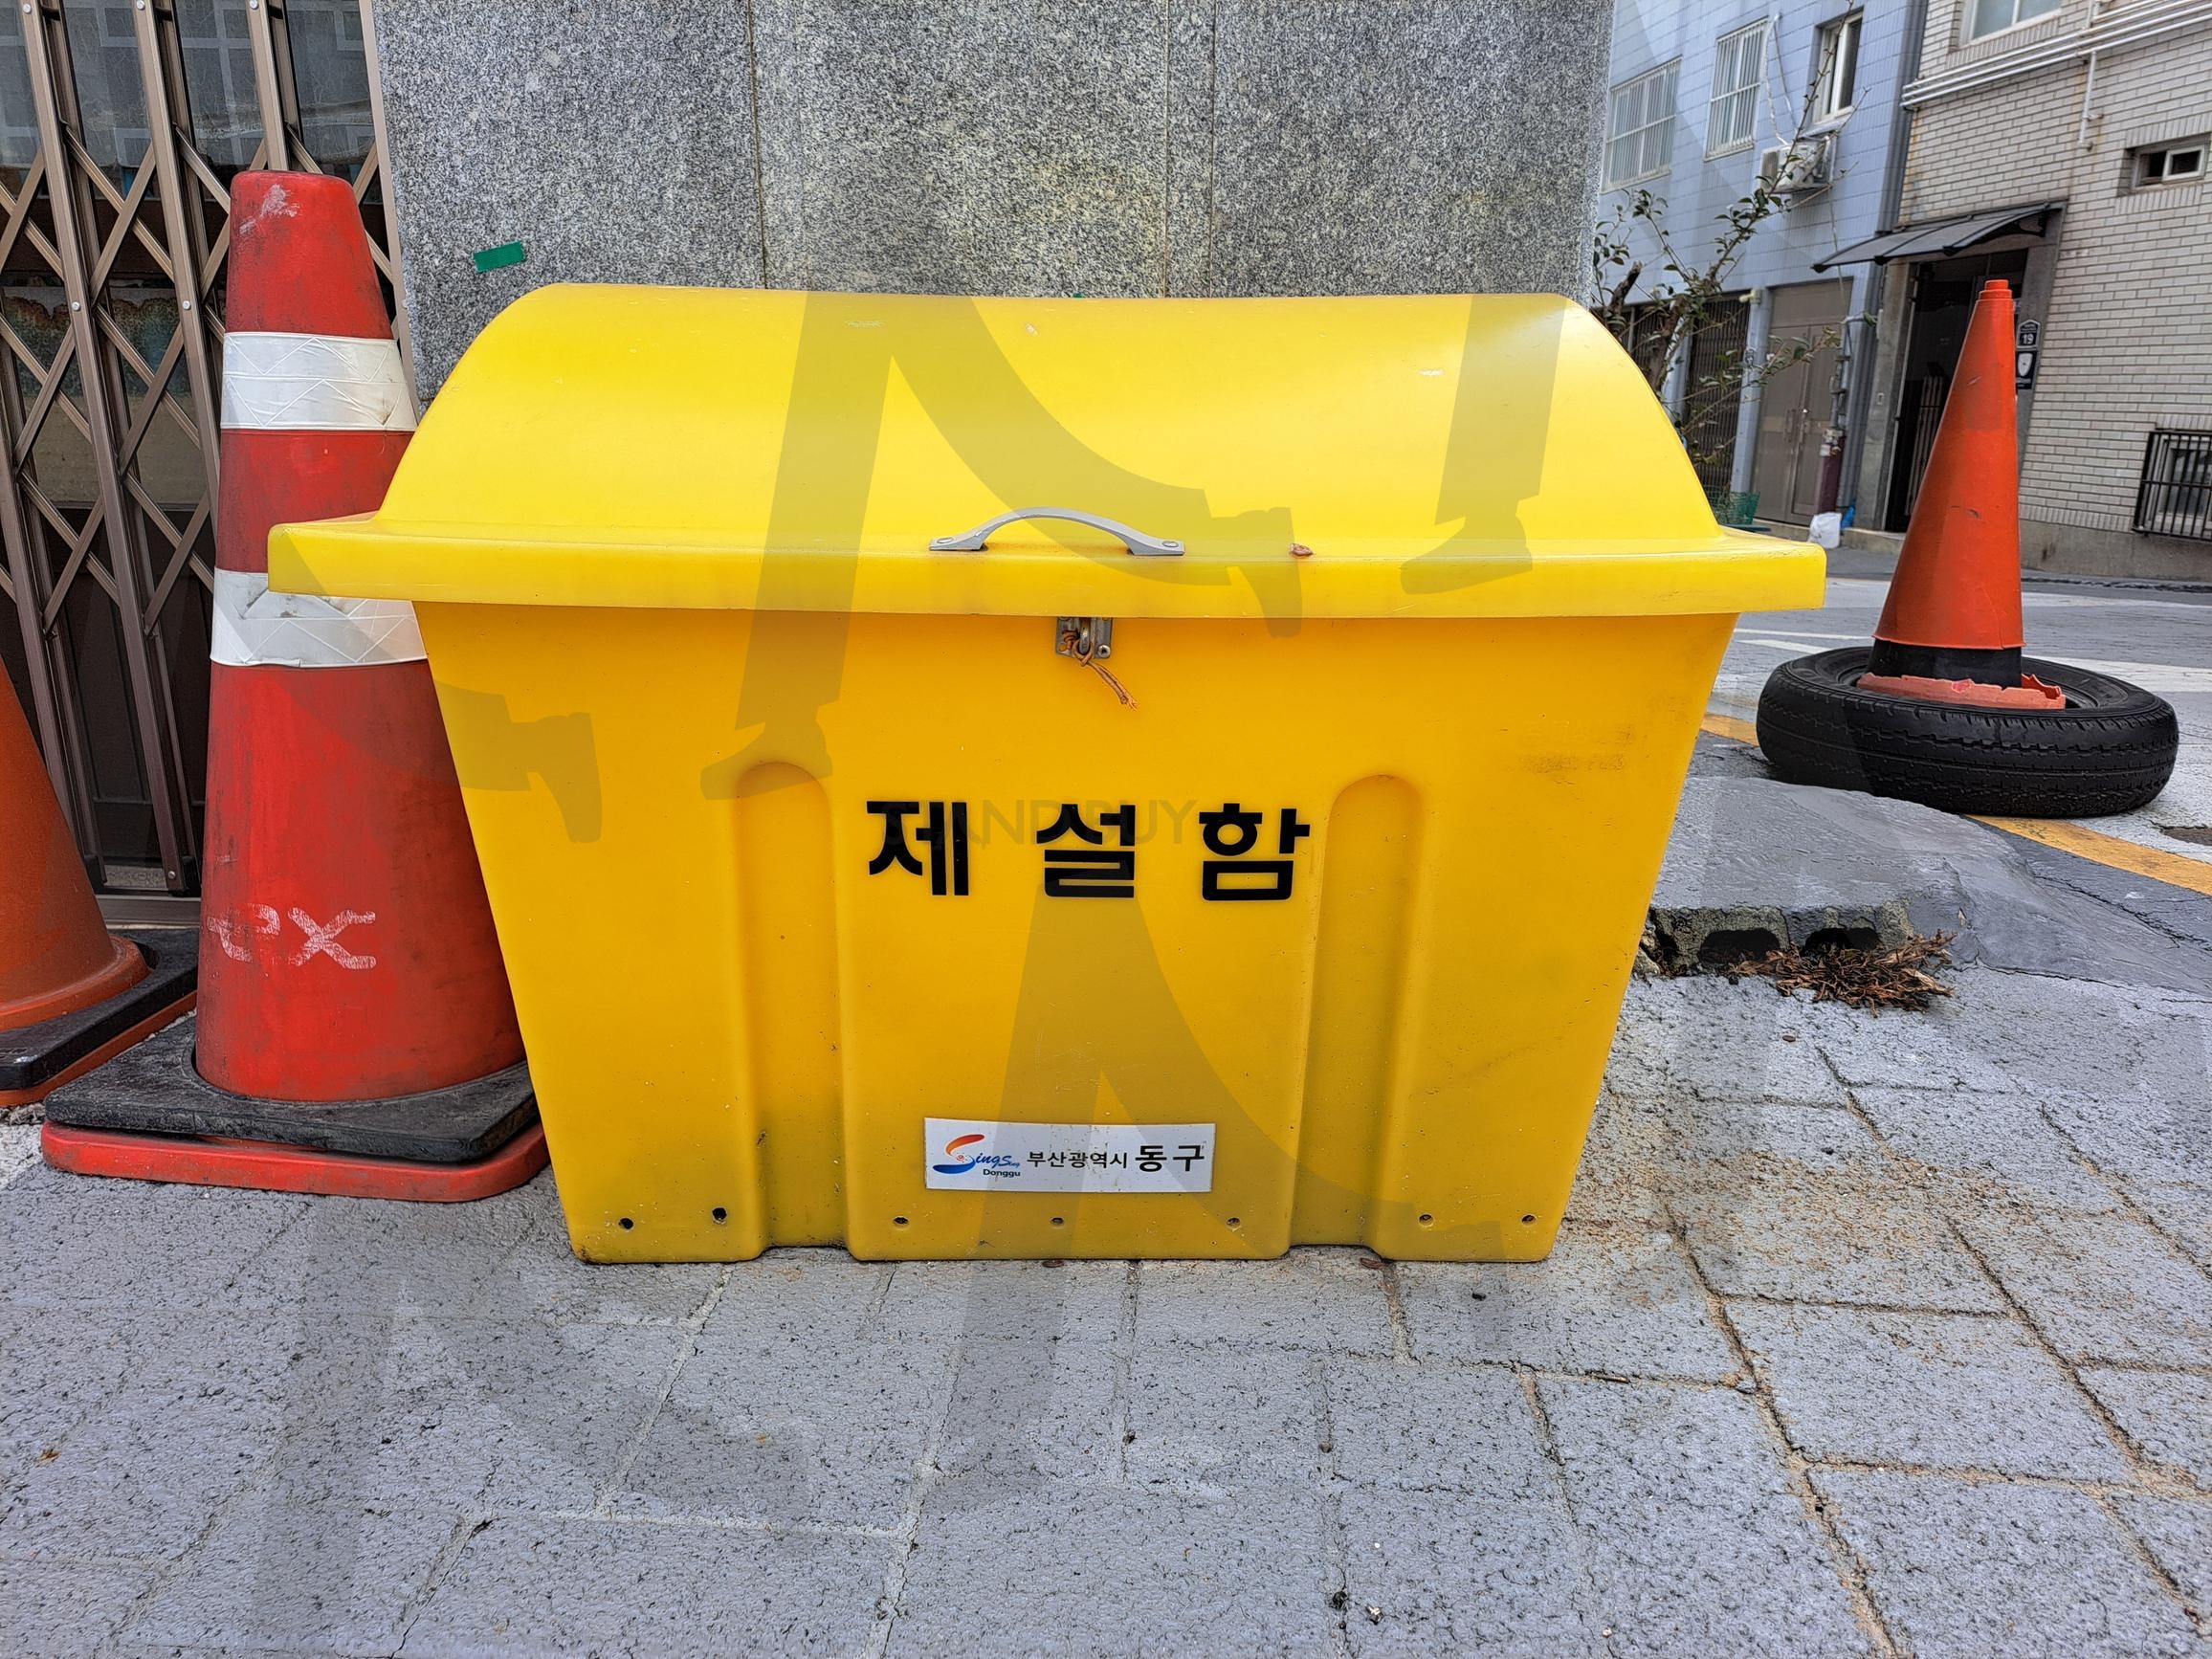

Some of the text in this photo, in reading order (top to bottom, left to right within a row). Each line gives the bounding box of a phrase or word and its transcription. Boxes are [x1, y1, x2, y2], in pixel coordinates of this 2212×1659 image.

[1027, 1145, 1205, 1172] 부산광역시 동구
[984, 1163, 1021, 1179] Donggu
